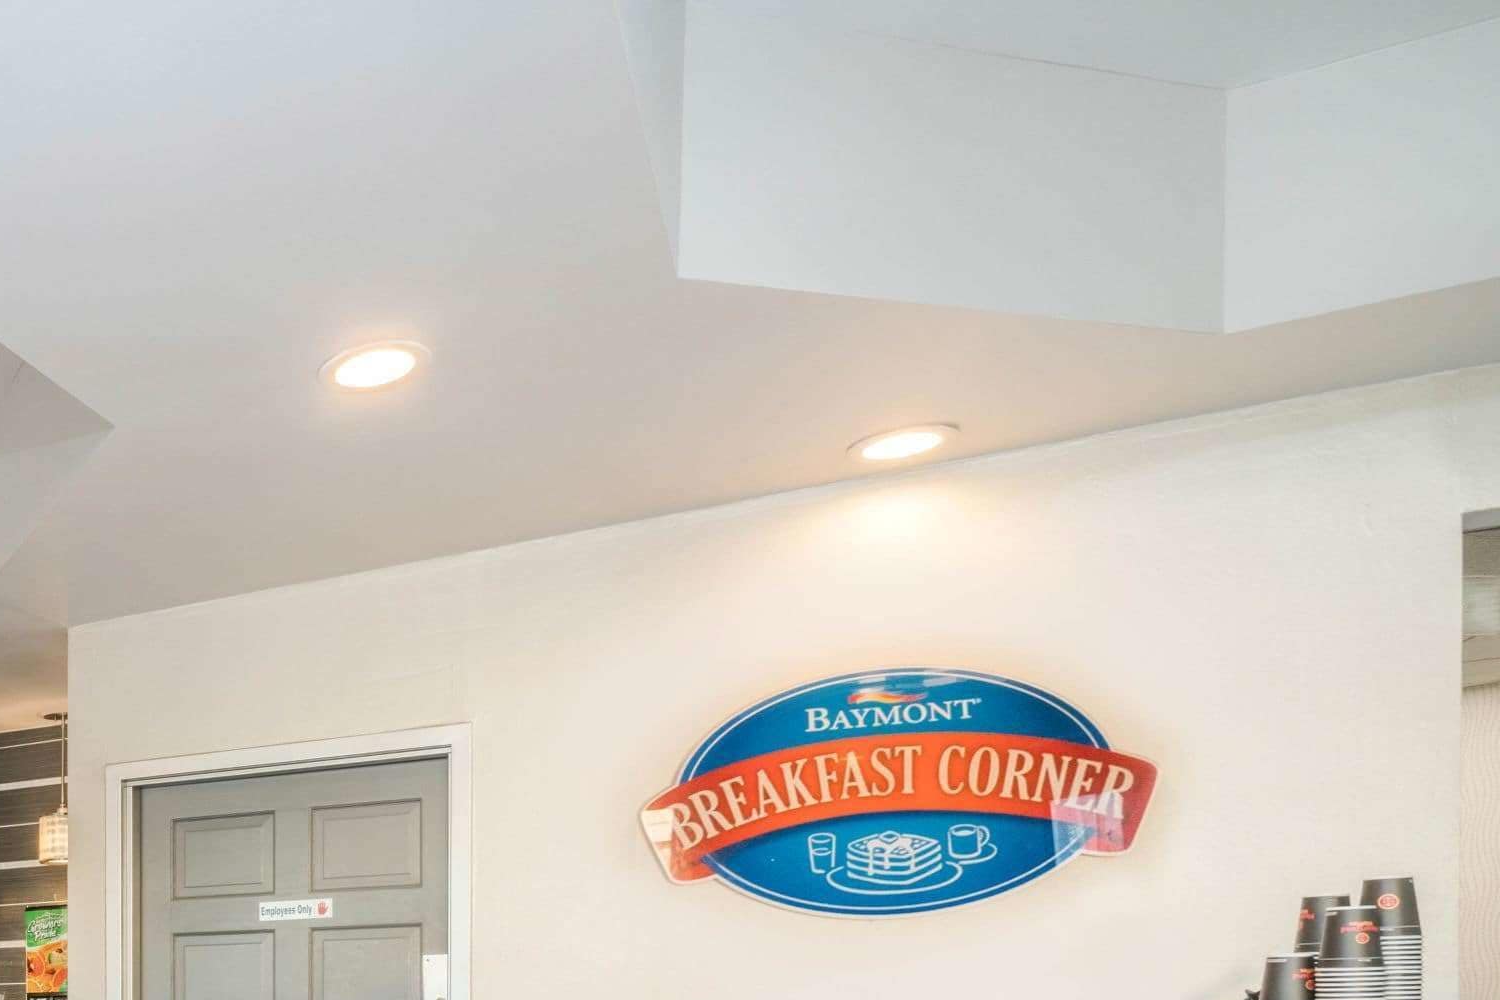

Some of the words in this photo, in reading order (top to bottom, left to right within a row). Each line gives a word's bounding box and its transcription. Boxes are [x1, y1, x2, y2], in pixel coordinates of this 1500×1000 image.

[805, 698, 975, 733] BAYMONT
[668, 744, 922, 851] BREAKFAST
[937, 743, 1135, 820] CORNER
[261, 906, 296, 917] Employees
[297, 904, 313, 915] Only
